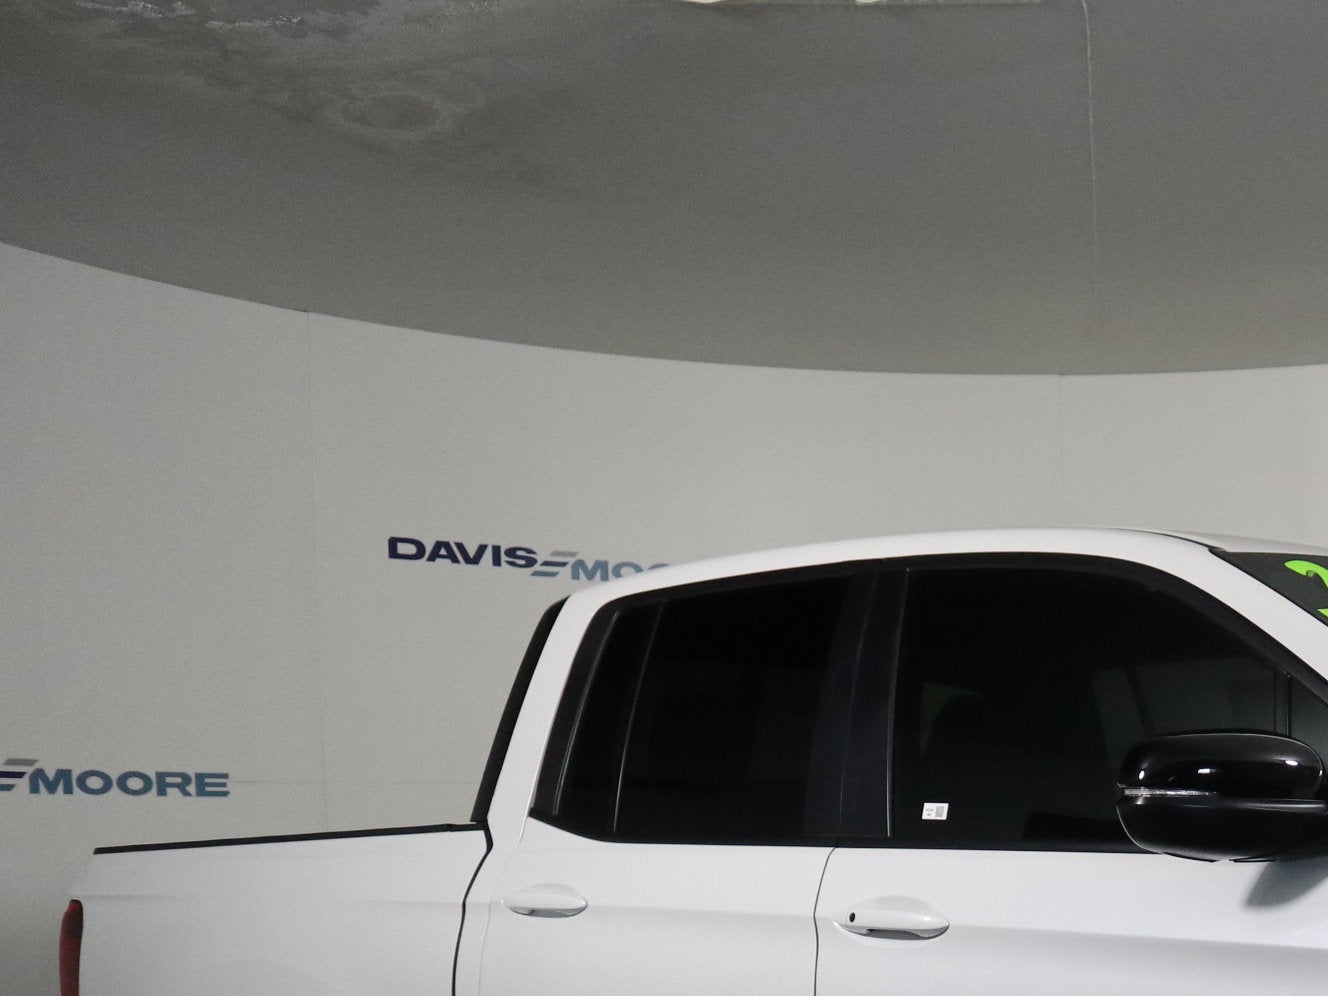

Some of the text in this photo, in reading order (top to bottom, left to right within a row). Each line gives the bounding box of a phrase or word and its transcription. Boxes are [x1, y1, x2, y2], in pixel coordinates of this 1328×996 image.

[387, 536, 670, 582] DAVIS MO
[28, 767, 230, 798] MOORE
